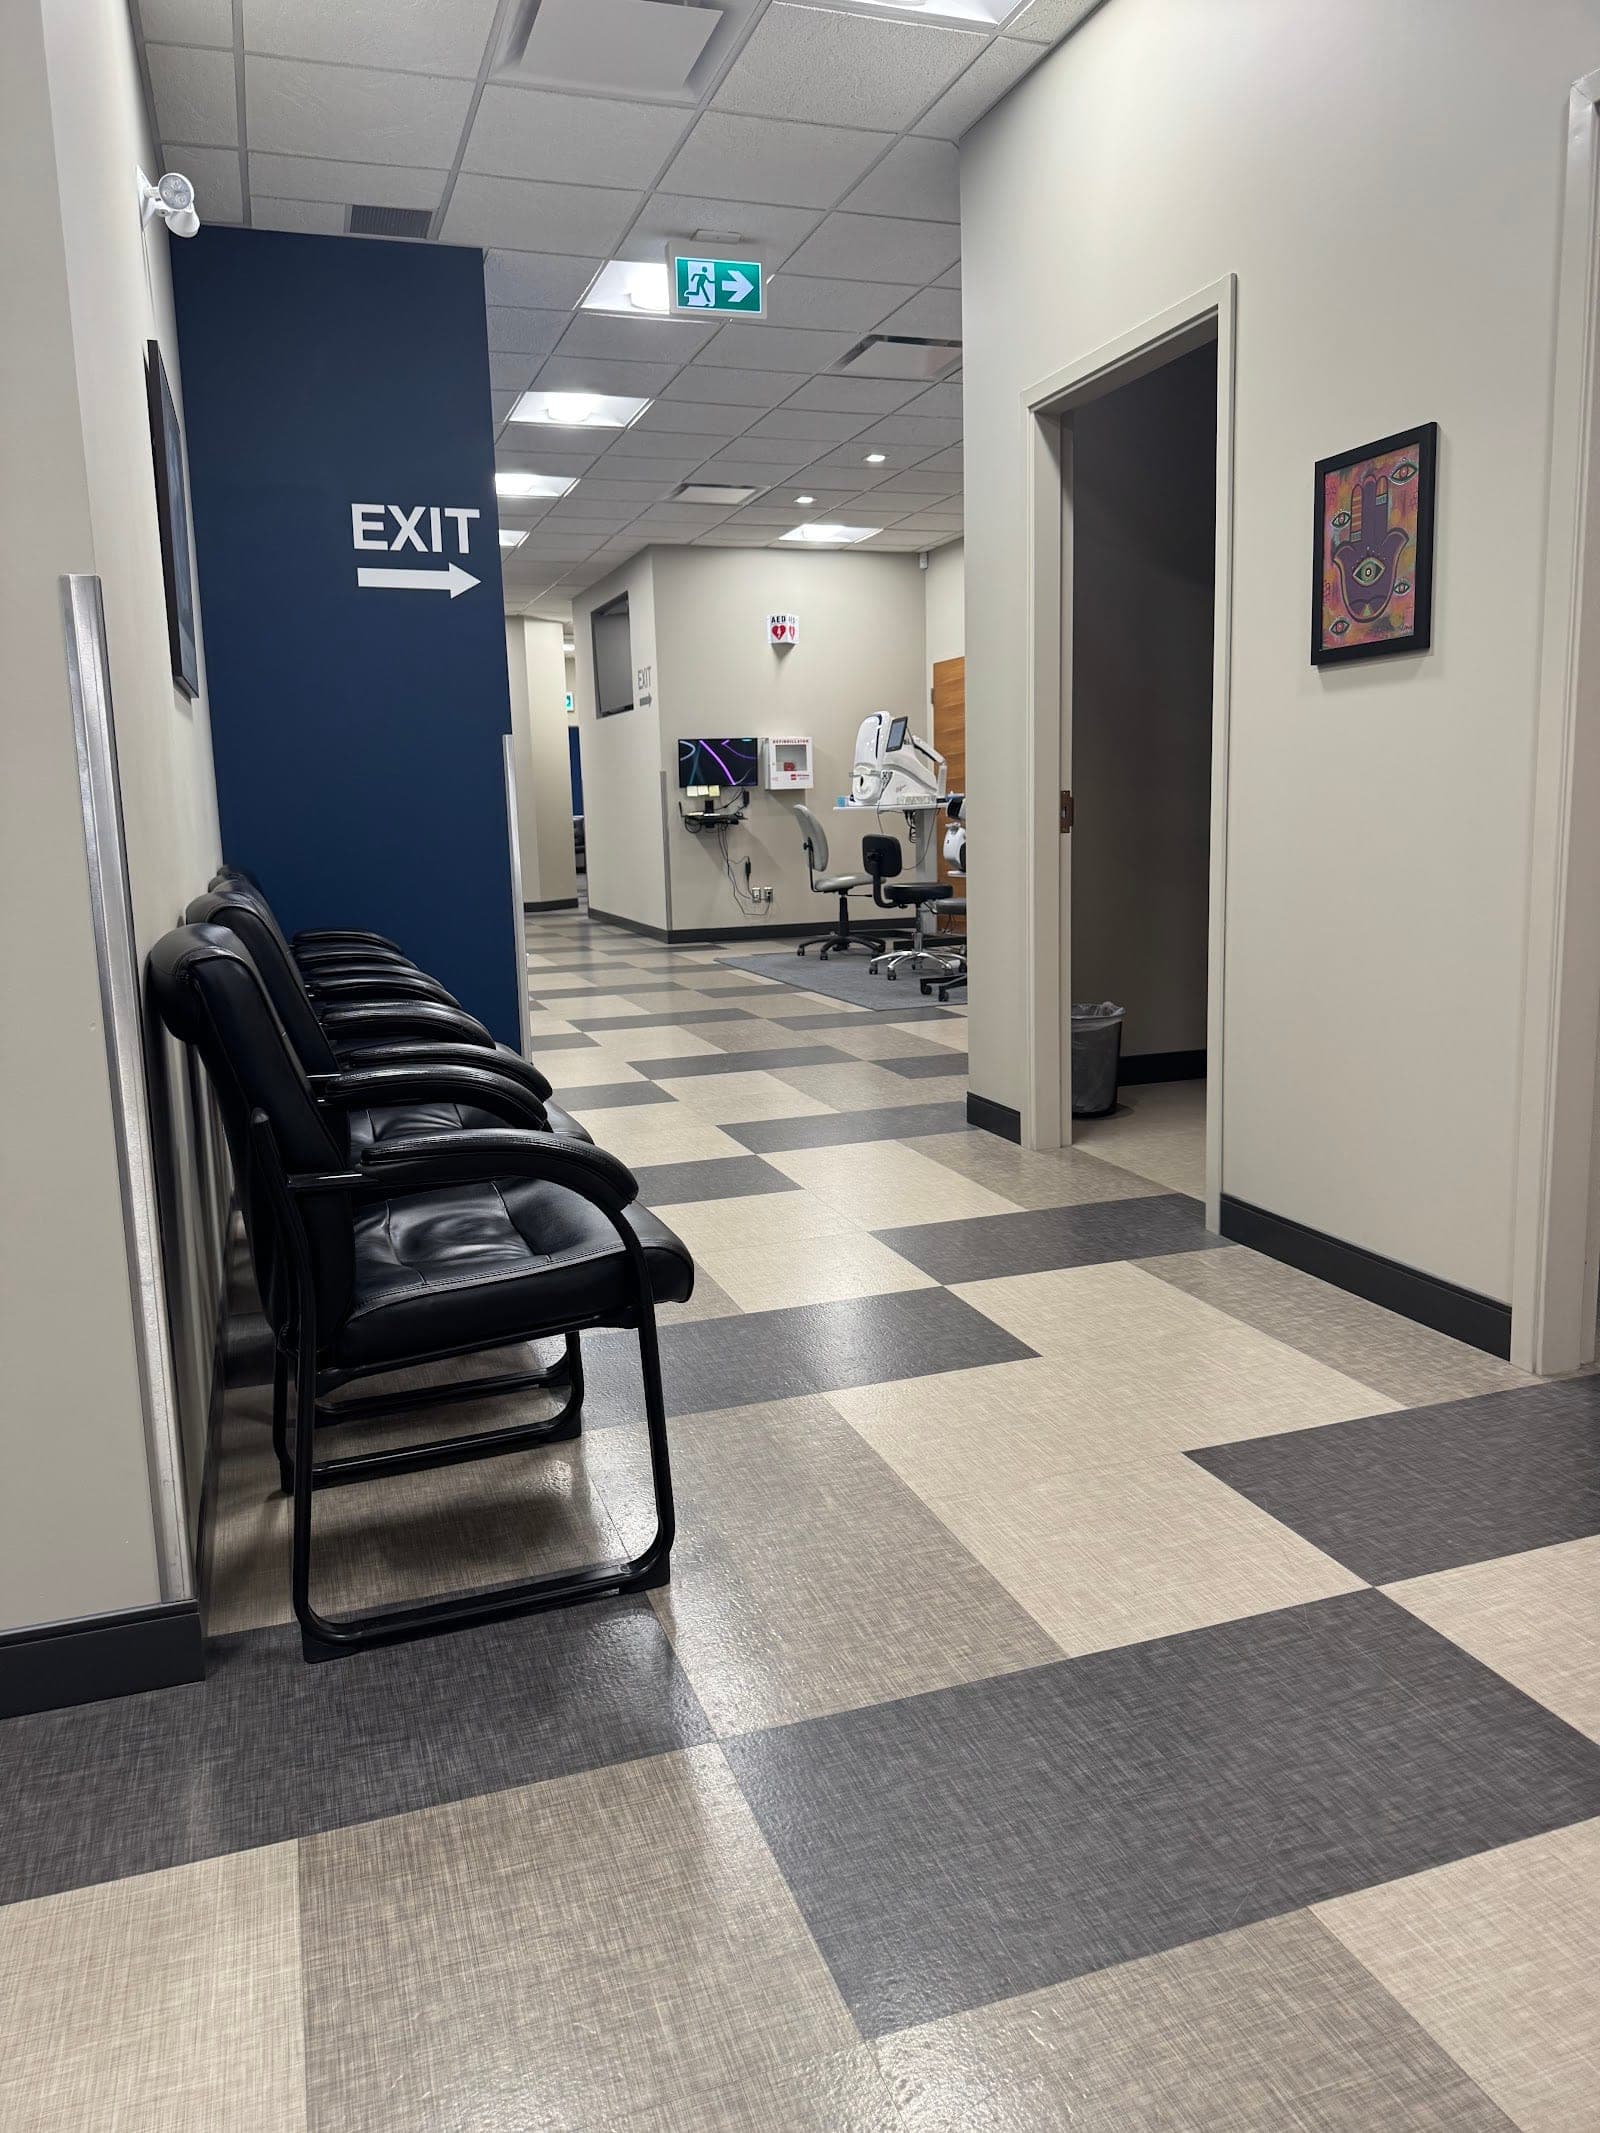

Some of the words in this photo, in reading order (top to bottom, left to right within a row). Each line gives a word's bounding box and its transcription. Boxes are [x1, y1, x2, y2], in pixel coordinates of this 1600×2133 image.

[351, 503, 480, 554] EXIT
[770, 615, 786, 624] AED
[637, 666, 651, 690] EXIT
